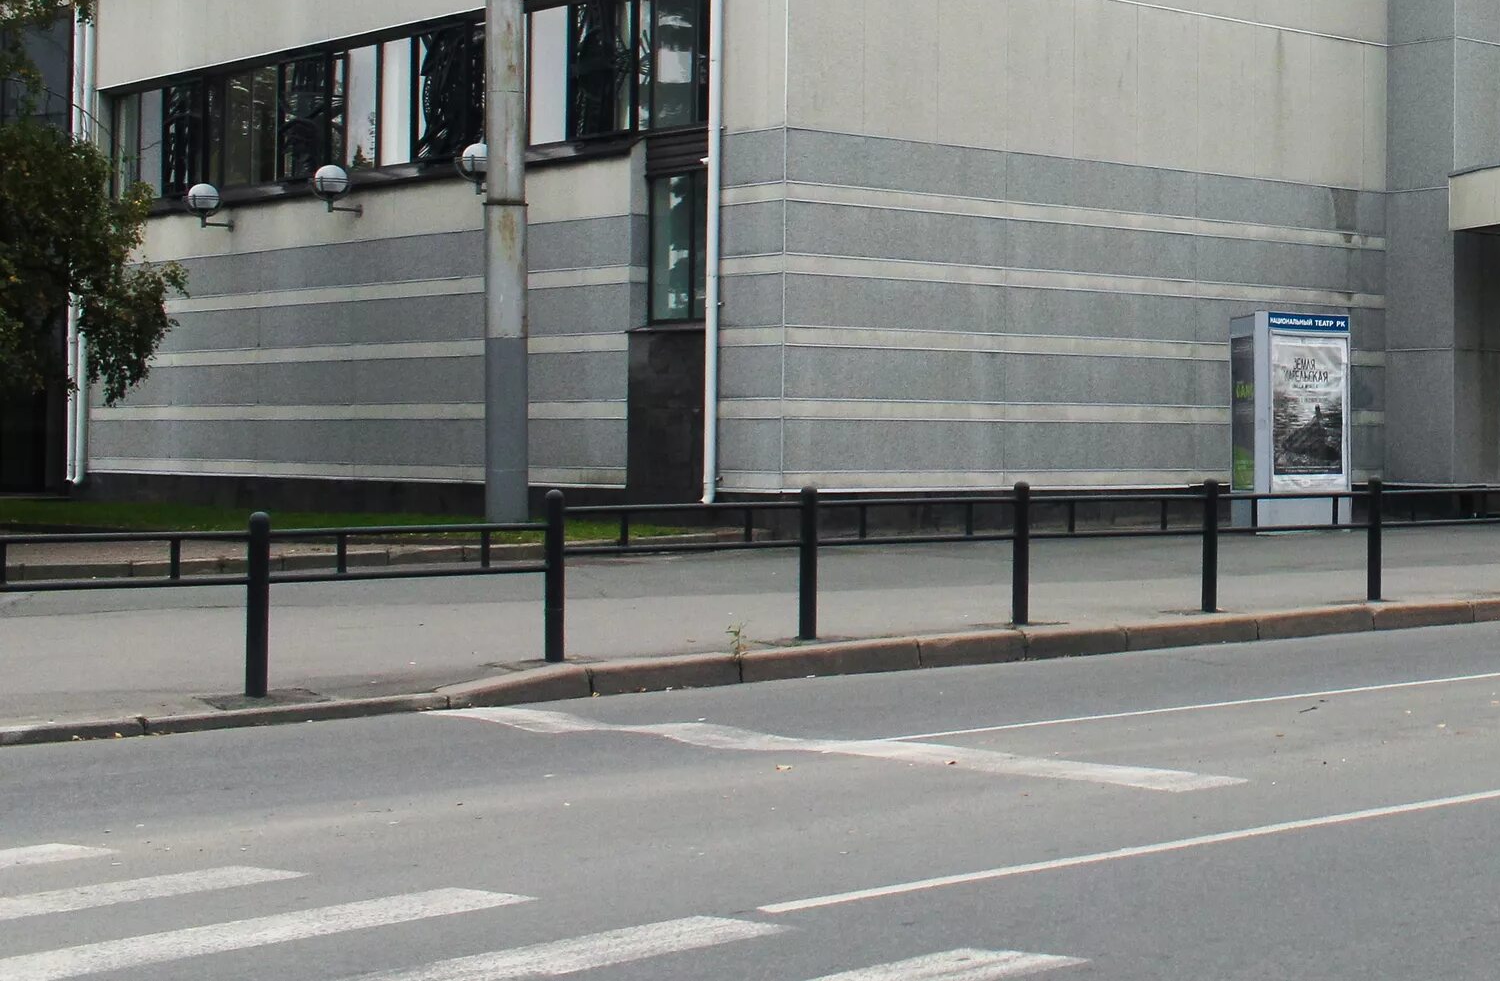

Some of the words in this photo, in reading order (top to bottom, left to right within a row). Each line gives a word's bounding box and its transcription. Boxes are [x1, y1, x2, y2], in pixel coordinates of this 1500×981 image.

[1270, 317, 1313, 326] НАЦИОНАЛЬНЫЙ
[1315, 319, 1334, 327] ТЕАТР
[1336, 320, 1346, 328] РК
[1293, 357, 1316, 370] ЗЕМЛЯ
